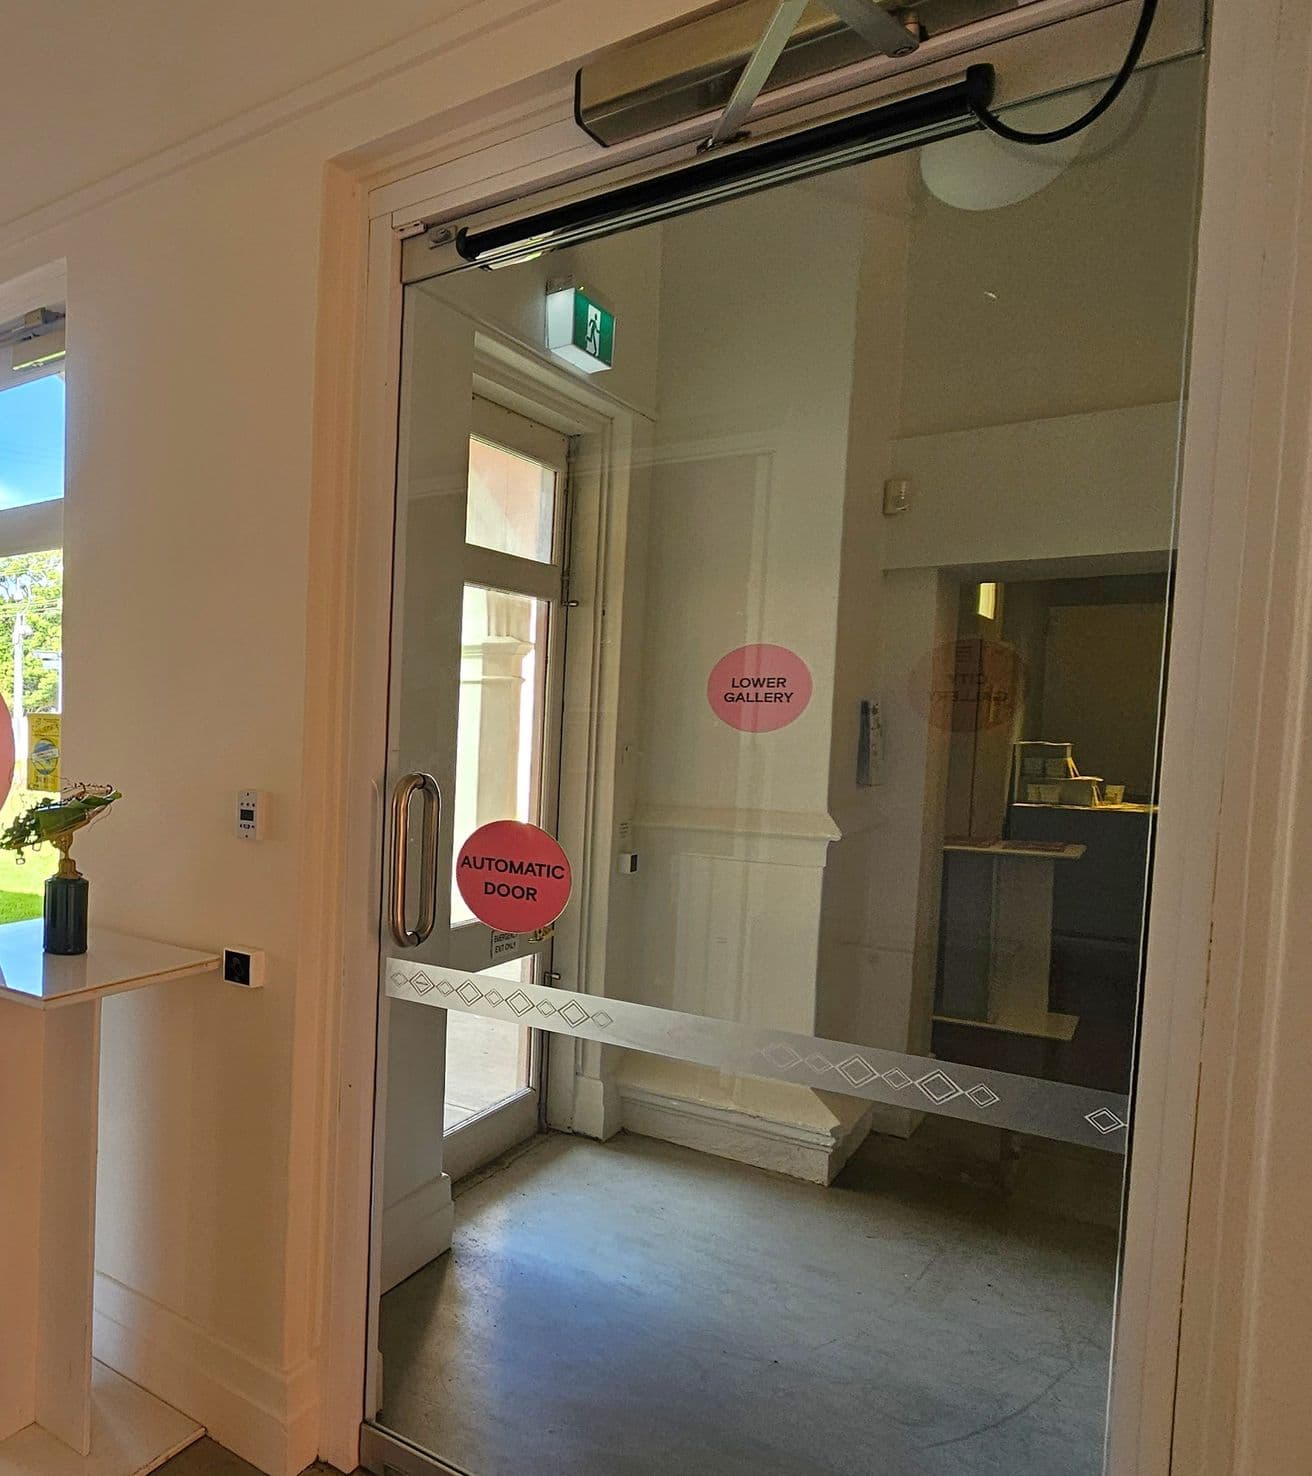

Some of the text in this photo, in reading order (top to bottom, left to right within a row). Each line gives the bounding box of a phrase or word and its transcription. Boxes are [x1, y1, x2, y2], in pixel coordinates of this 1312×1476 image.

[731, 677, 787, 689] LOWER
[723, 691, 794, 704] GALLERY
[460, 856, 565, 880] AUTOMATIC
[484, 882, 538, 902] DOOR
